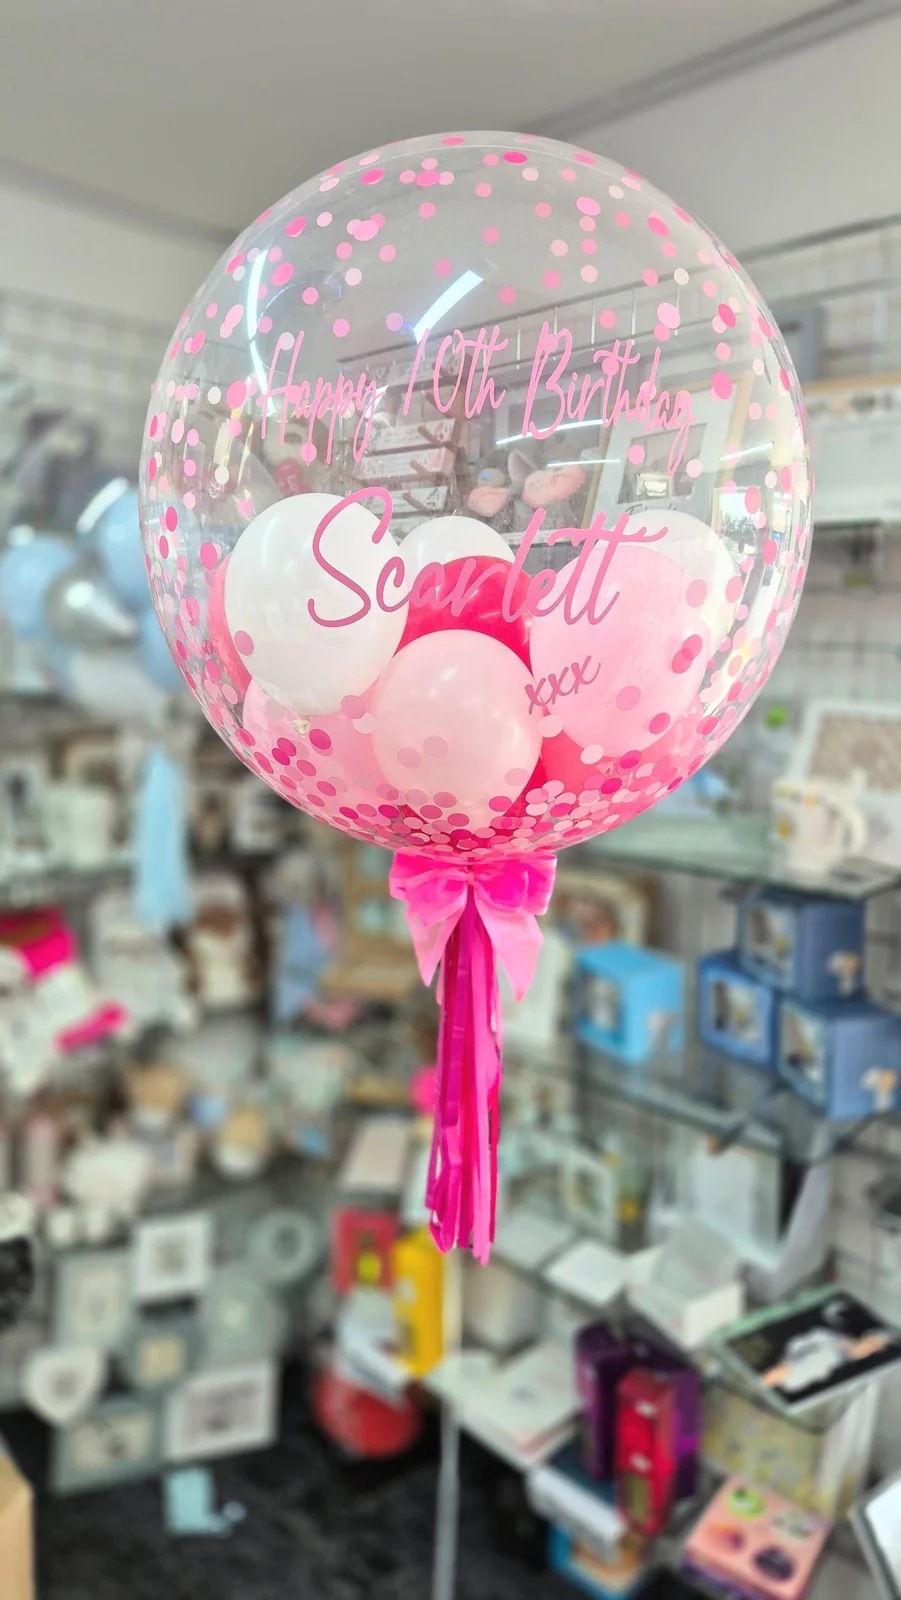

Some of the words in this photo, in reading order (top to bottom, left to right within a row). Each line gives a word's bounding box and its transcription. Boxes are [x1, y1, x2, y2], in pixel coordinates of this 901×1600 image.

[255, 330, 389, 466] Happy
[402, 325, 509, 419] 10th
[521, 321, 698, 478] Birthday
[307, 486, 669, 628] Scarlett
[524, 655, 602, 715] xxx
